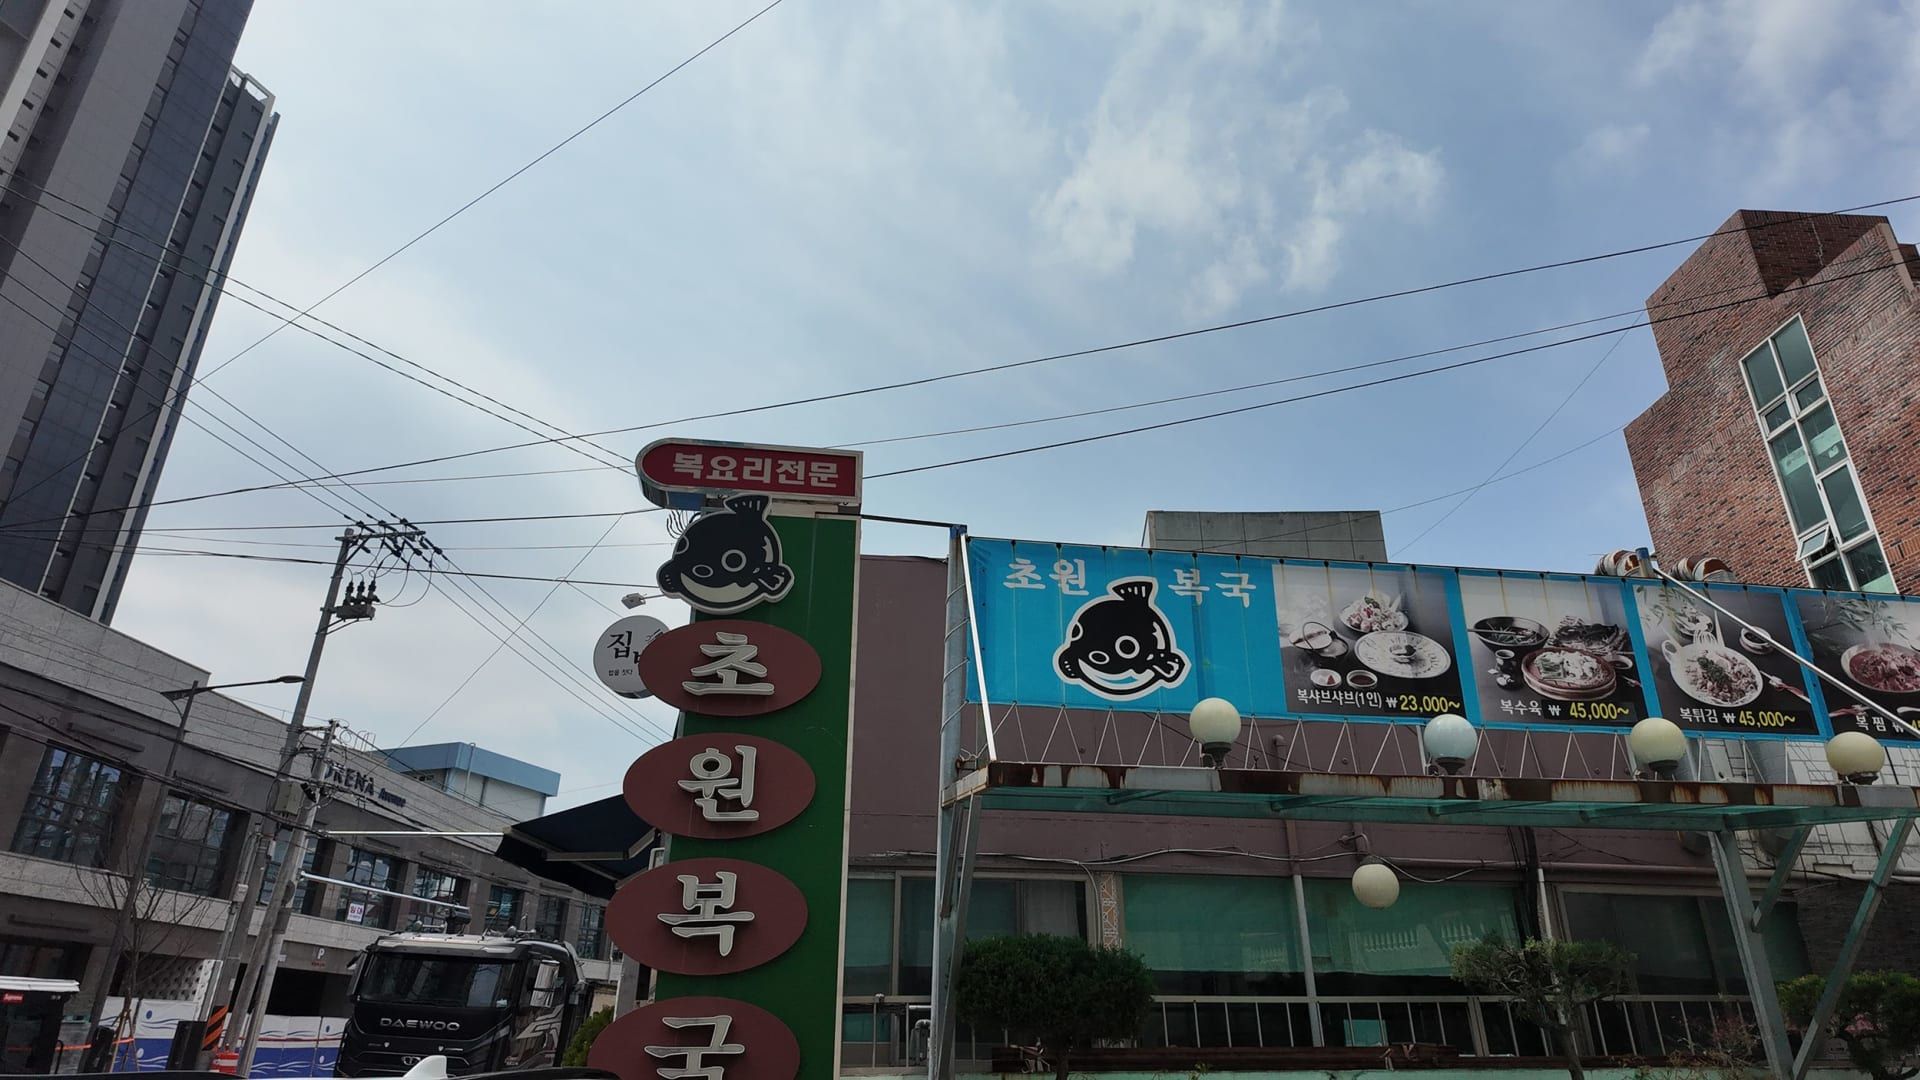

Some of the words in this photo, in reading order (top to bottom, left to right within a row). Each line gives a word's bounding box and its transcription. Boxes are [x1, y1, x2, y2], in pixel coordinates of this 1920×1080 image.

[672, 452, 839, 488] 복요리전문
[1003, 557, 1090, 596] 초원
[1500, 699, 1542, 717] 복수육
[1679, 707, 1718, 724] 복튀김
[317, 948, 325, 959] P
[380, 1017, 460, 1031] DAEWOO
